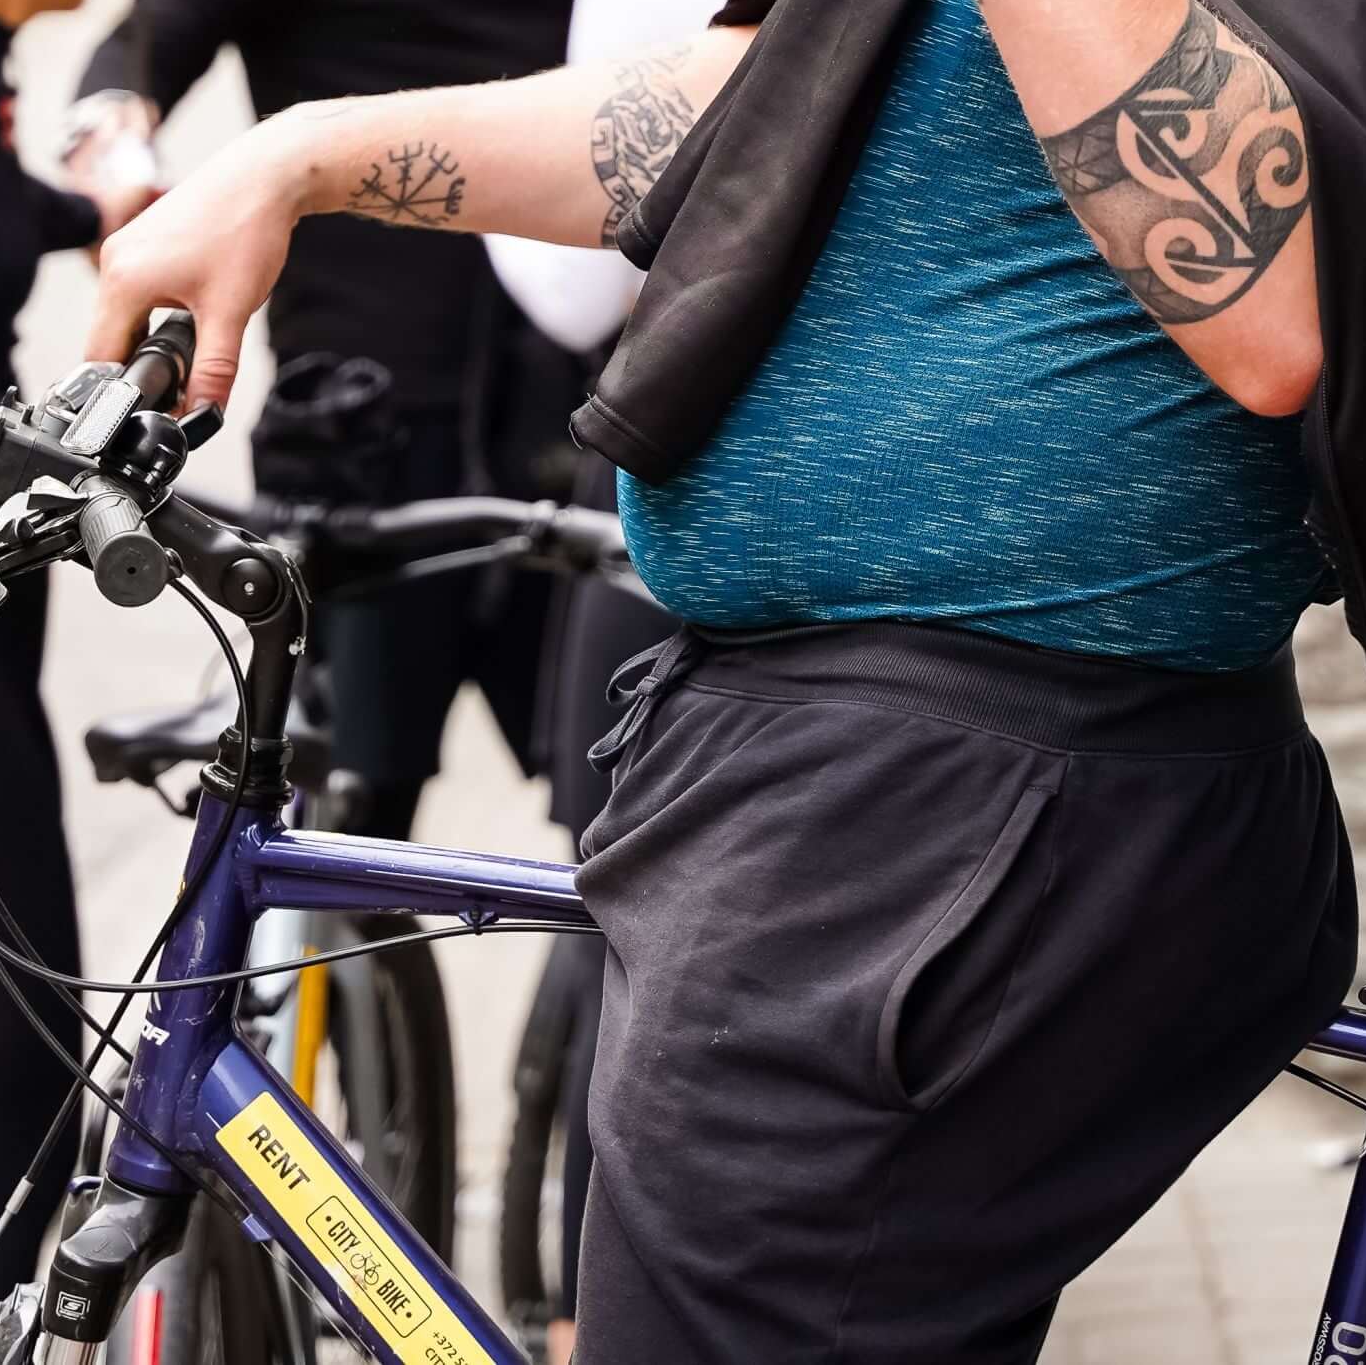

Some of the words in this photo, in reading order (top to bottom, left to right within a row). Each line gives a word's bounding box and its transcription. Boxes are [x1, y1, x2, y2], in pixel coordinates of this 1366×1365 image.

[247, 1123, 311, 1190] RENT
[327, 1220, 361, 1253] CITY
[376, 1278, 411, 1315] BIKE
[425, 1347, 446, 1365] CIT
[432, 1331, 457, 1359] +372
